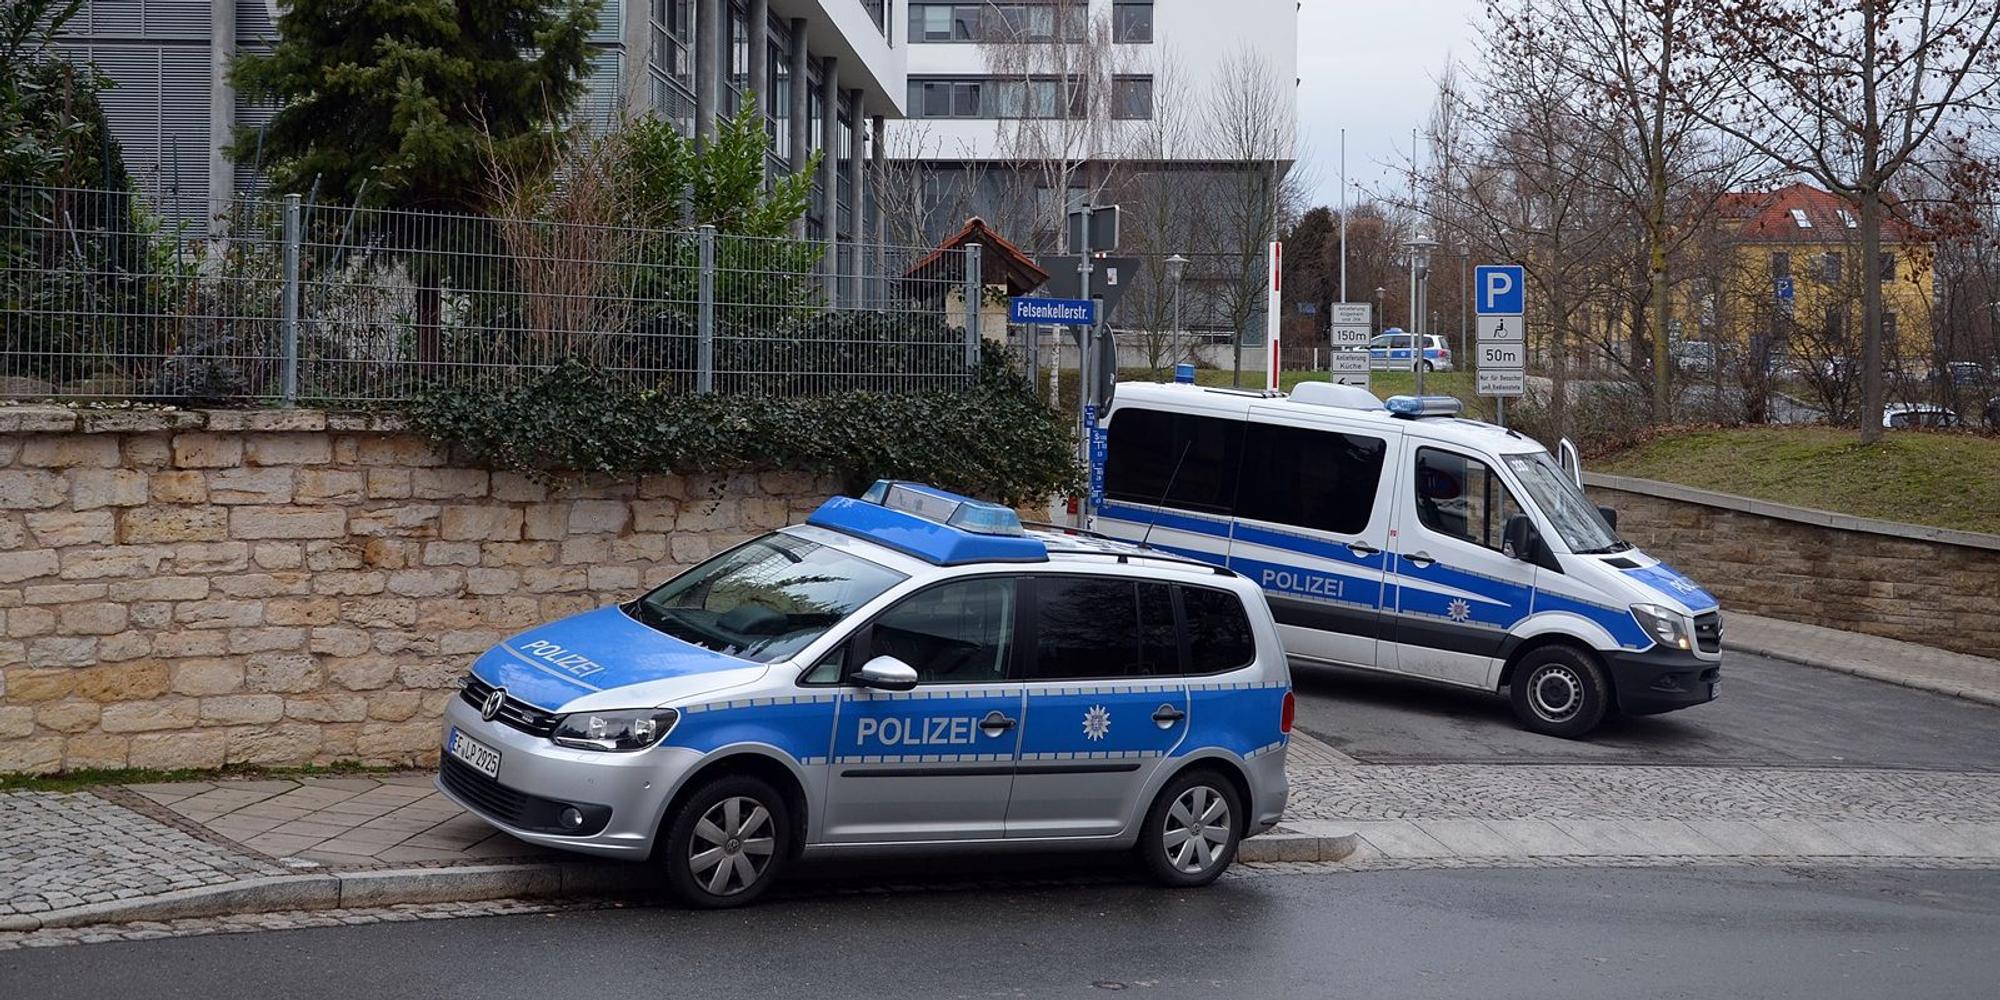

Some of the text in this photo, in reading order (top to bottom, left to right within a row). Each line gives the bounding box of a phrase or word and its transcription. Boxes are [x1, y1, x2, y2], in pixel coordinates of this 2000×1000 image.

[1487, 272, 1513, 308] P
[1017, 301, 1088, 320] Felsenkellerstr.
[1337, 330, 1367, 341] 150m
[1486, 349, 1516, 361] 50m
[1262, 569, 1344, 598] POLIZEI
[520, 640, 605, 678] POLIZEI
[857, 717, 977, 745] POLIZEI
[475, 747, 498, 773] 2925
